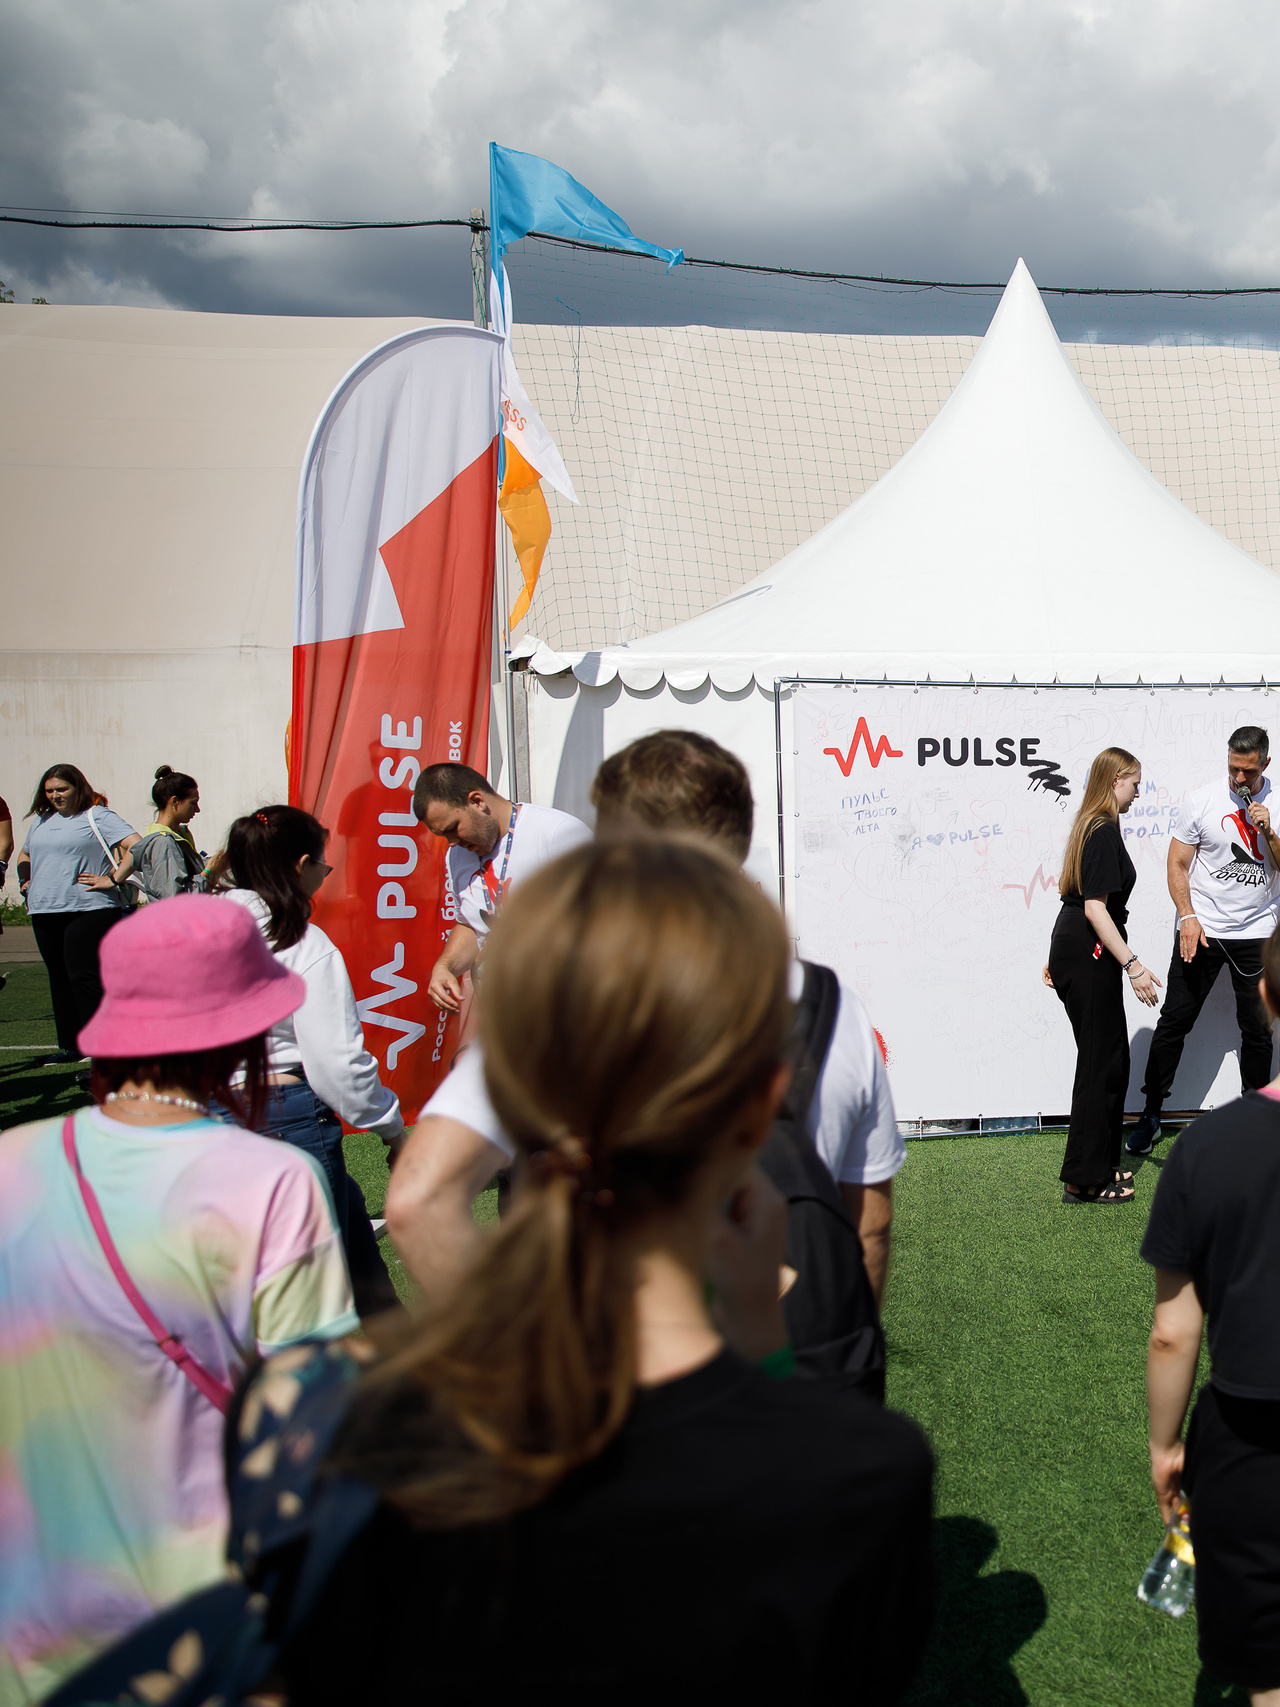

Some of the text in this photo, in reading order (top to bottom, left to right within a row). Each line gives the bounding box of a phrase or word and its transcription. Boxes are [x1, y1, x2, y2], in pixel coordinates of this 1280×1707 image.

[918, 737, 1041, 767] PULSE
[841, 788, 890, 810] ПУЛЬС
[377, 713, 422, 919] PULSE
[854, 806, 897, 821] ТВОЕГО
[855, 823, 880, 835] ЛЕТА
[949, 823, 1004, 845] PULSE
[1210, 870, 1266, 887] ГОРОДА
